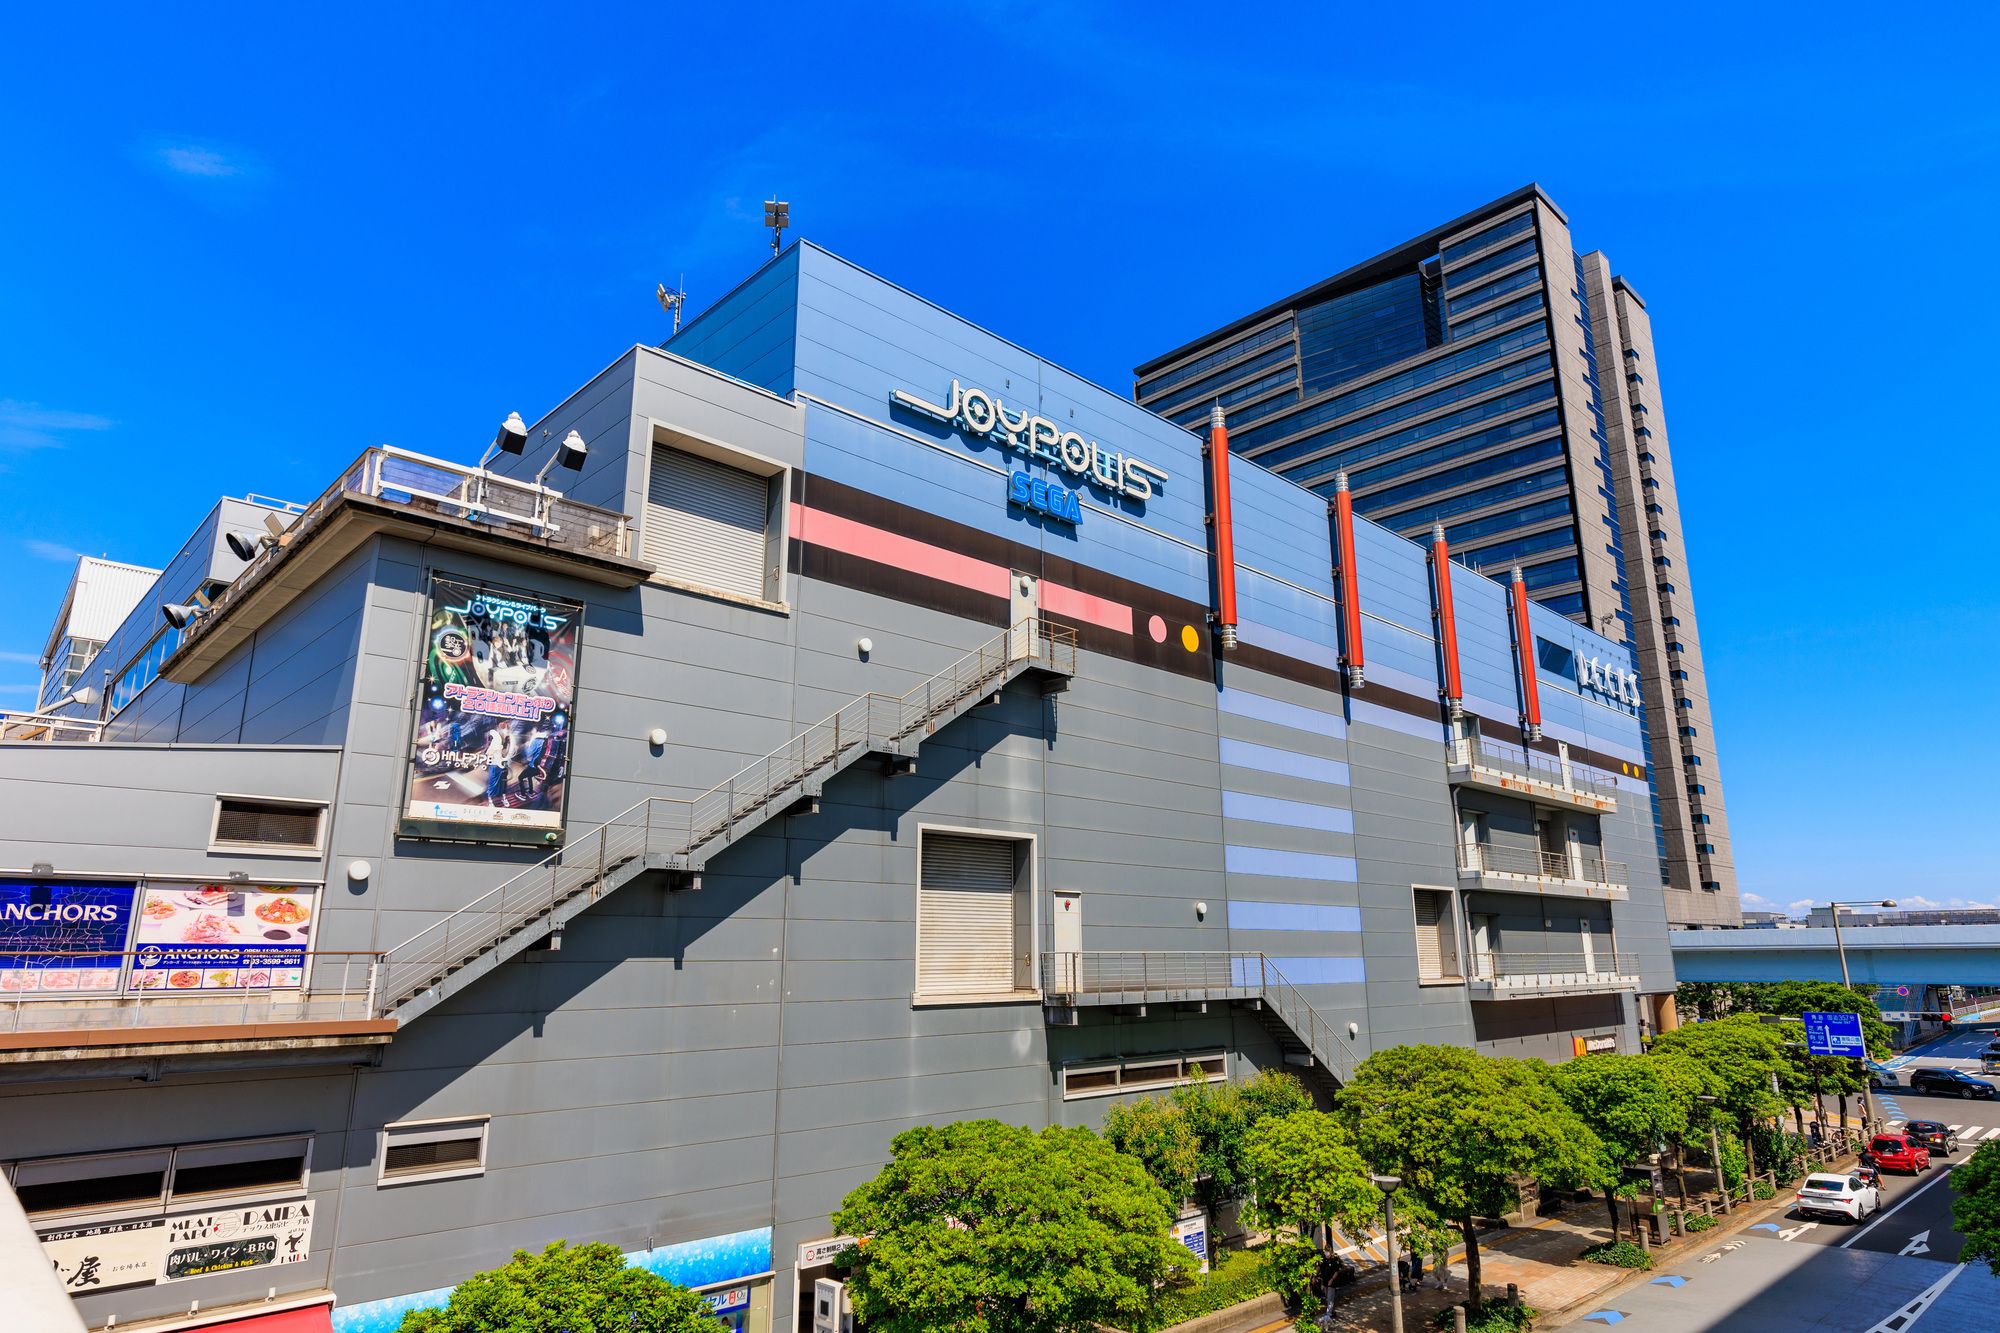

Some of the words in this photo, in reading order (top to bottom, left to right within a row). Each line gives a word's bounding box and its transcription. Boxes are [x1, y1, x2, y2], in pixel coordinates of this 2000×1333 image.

[892, 378, 1169, 500] JOYPOLIS
[1009, 471, 1083, 525] SEGA
[444, 600, 567, 630] JOYPOLIS
[441, 750, 493, 765] HALFPIPE
[446, 761, 487, 771] TOKYO
[163, 948, 240, 959] ANCHORS
[243, 1204, 310, 1225] DAIBA
[170, 1217, 213, 1231] MEAT
[169, 1228, 212, 1242] LABO
[189, 1267, 203, 1275] Beef
[211, 1263, 233, 1271] Chicken
